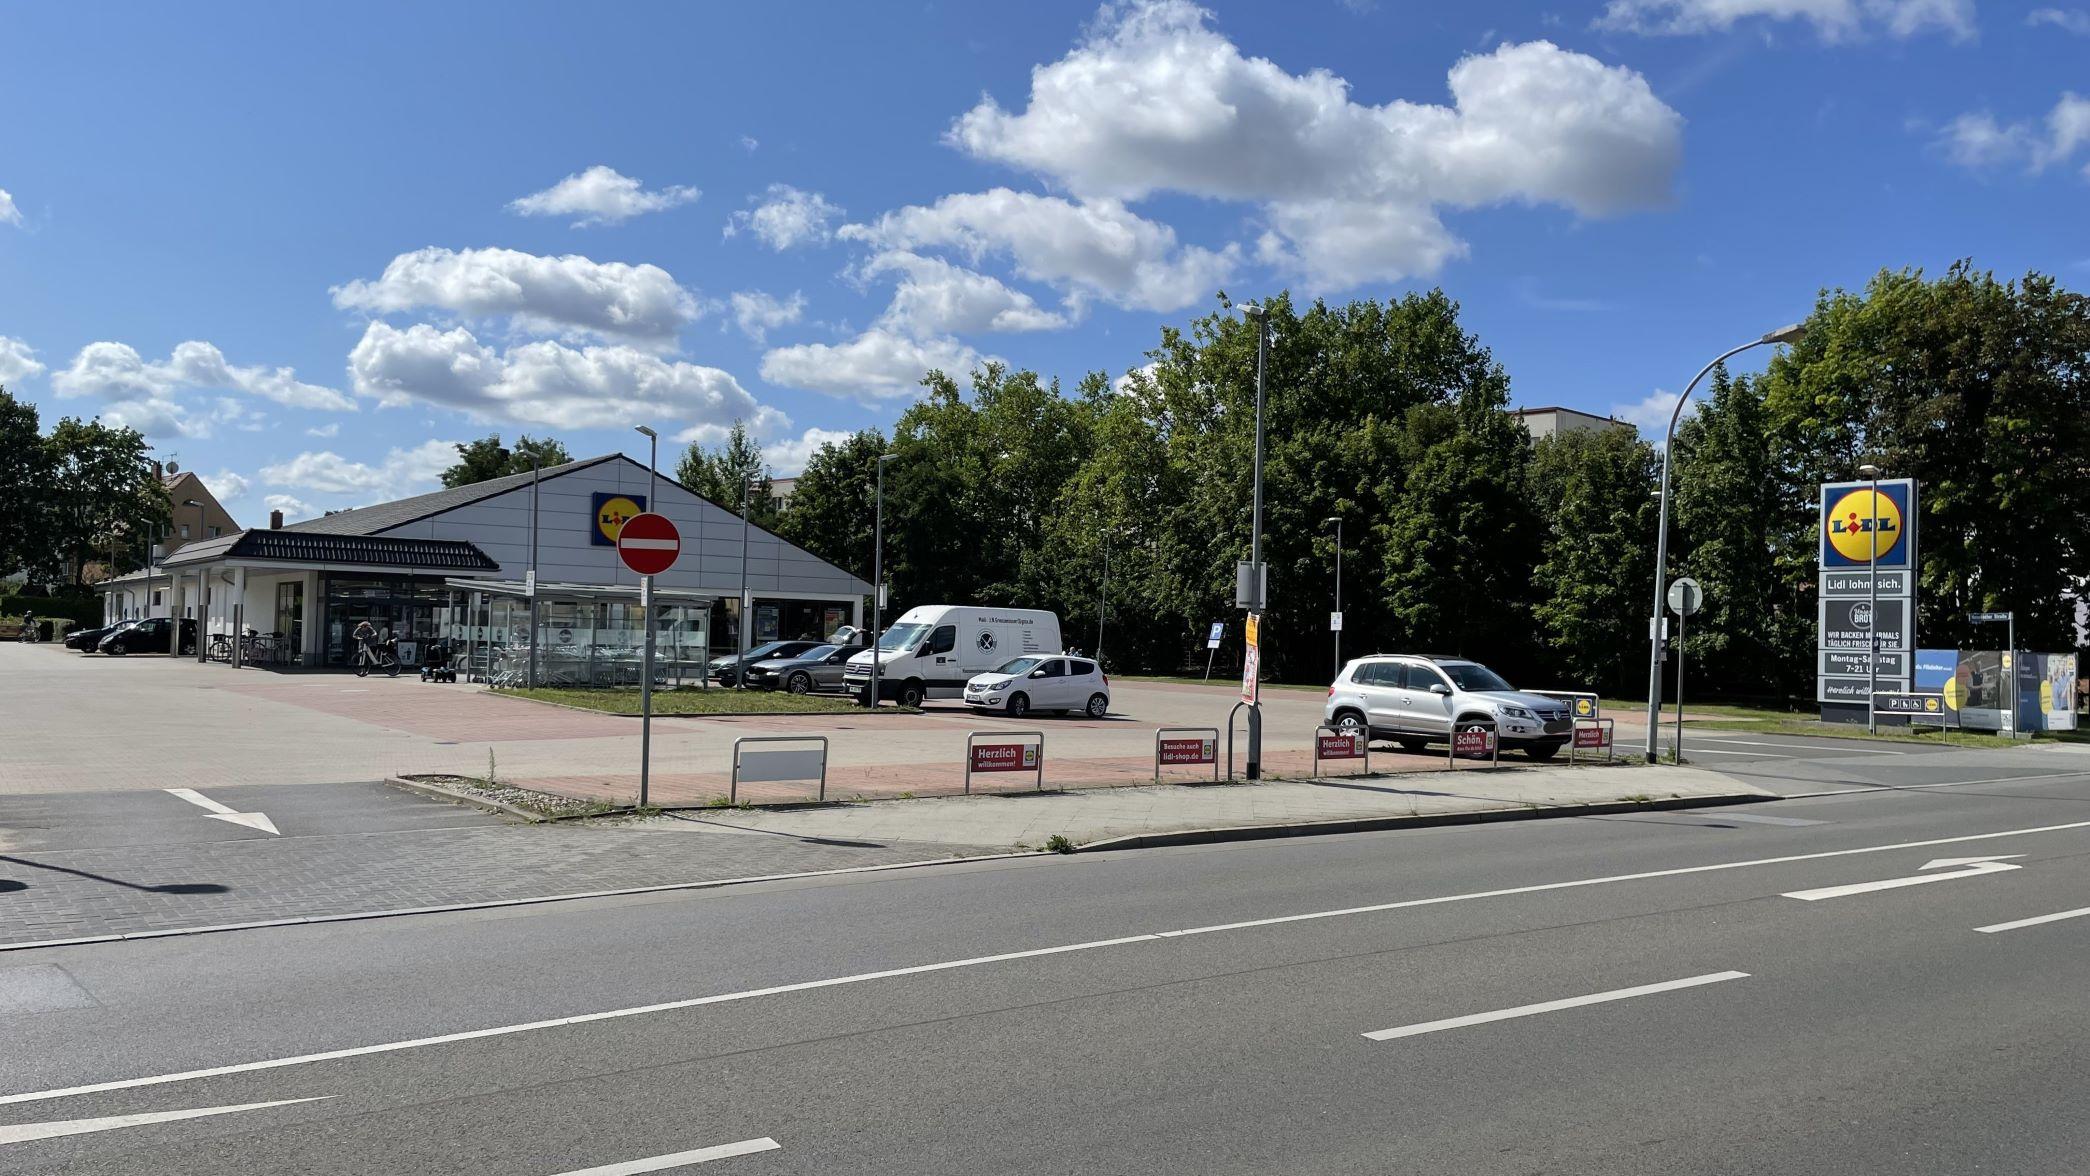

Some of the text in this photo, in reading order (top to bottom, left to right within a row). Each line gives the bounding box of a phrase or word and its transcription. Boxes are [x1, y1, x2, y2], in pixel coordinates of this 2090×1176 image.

[1827, 578, 1901, 590] Lidl lohn sich.
[1213, 625, 1221, 637] P
[1827, 631, 1840, 639] WIR
[1840, 631, 1864, 639] BACKEN
[1827, 639, 1851, 648] TÄGLICH
[1852, 640, 1872, 648] FRISC
[1845, 664, 1880, 673] 7-21 Ur
[1578, 730, 1600, 738] Herzlich
[1322, 738, 1350, 748] Herzlich
[1457, 734, 1483, 745] Schön,
[977, 747, 1017, 759] Herzlich
[1163, 752, 1200, 762] lidl-shop.de
[976, 760, 1017, 768] willkommen!
